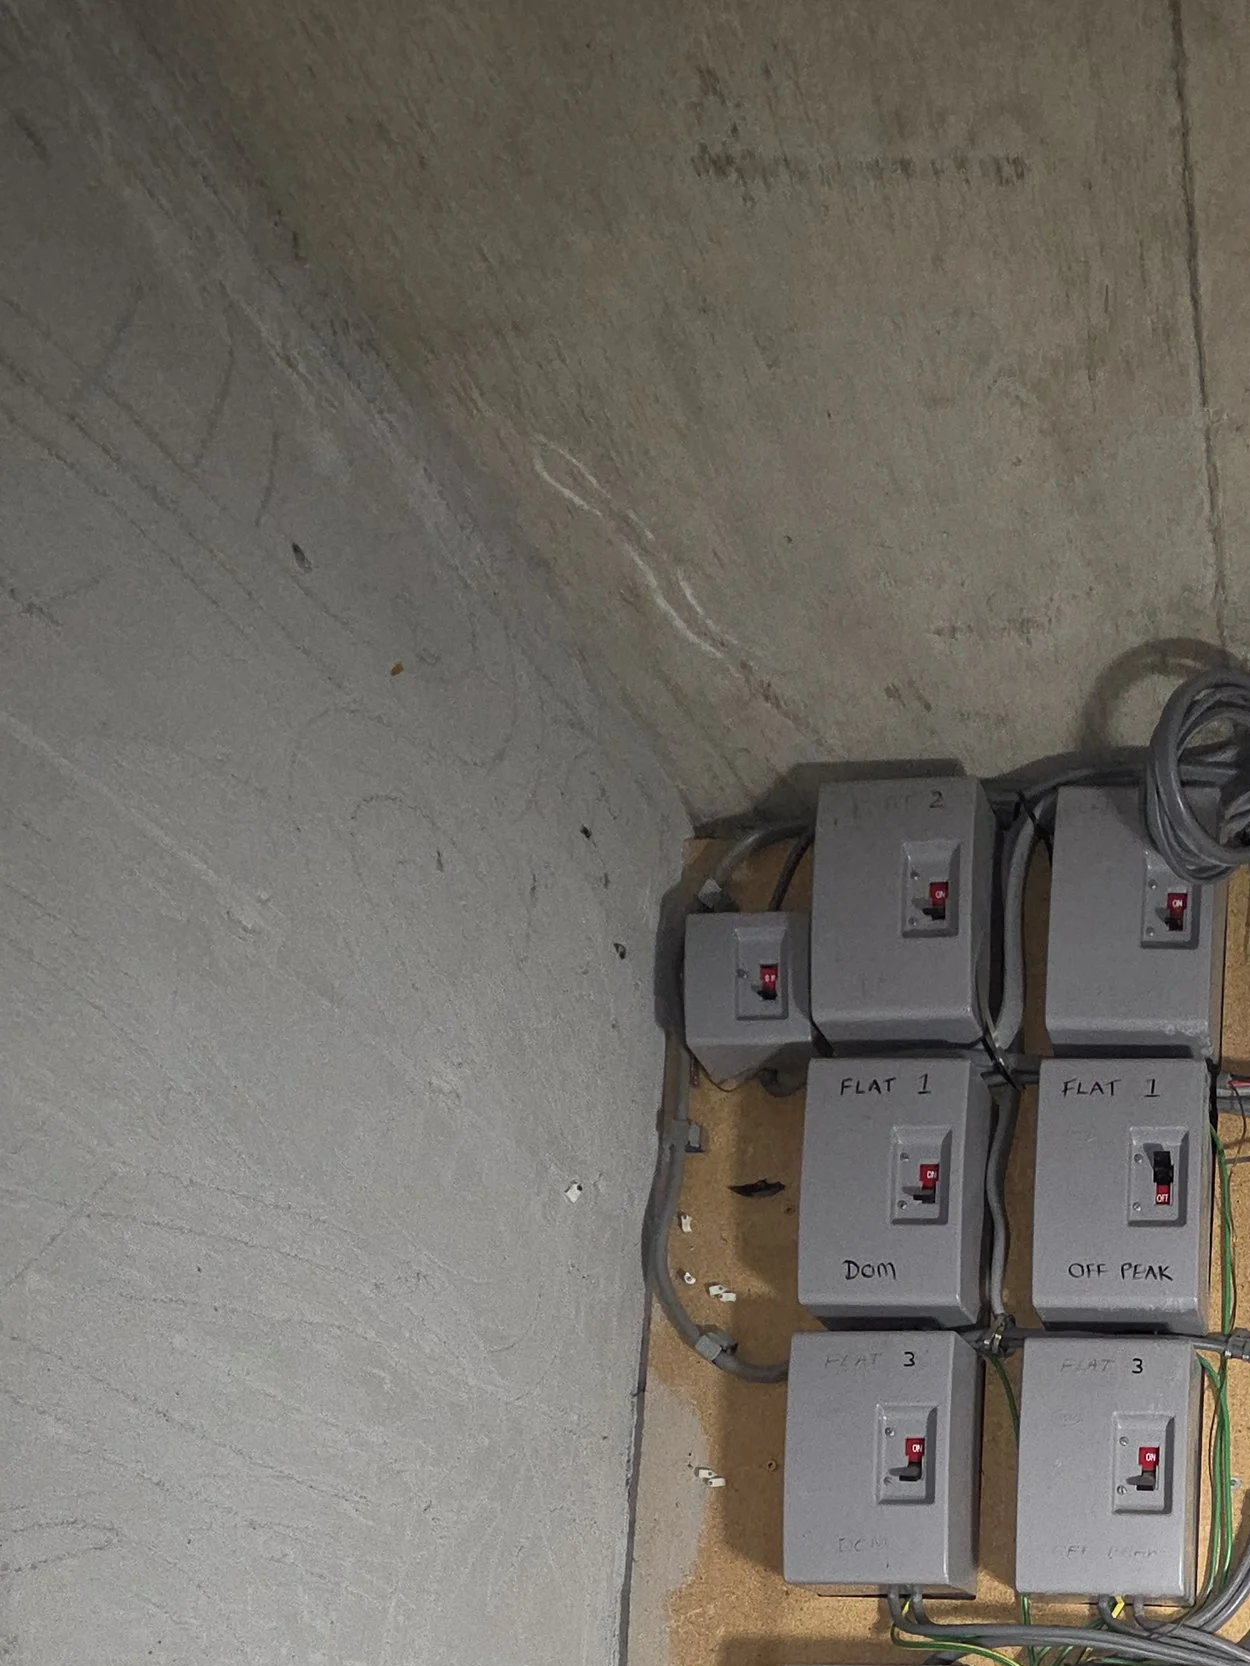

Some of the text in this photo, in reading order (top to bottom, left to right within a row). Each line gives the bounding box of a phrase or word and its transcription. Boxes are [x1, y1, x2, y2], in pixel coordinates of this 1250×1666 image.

[929, 790, 944, 809] 2
[935, 890, 946, 899] ON
[1172, 899, 1183, 908] ON
[840, 1073, 932, 1096] FLAT 1
[1061, 1078, 1160, 1098] FLAT 1
[926, 1170, 938, 1180] ON
[1156, 1193, 1170, 1203] OFF
[842, 1260, 897, 1280] DOM
[1068, 1262, 1174, 1282] OFF PEAK
[903, 1351, 916, 1367] 3
[1131, 1357, 1143, 1374] 3
[912, 1443, 923, 1453] ON
[1146, 1453, 1157, 1462] ON
